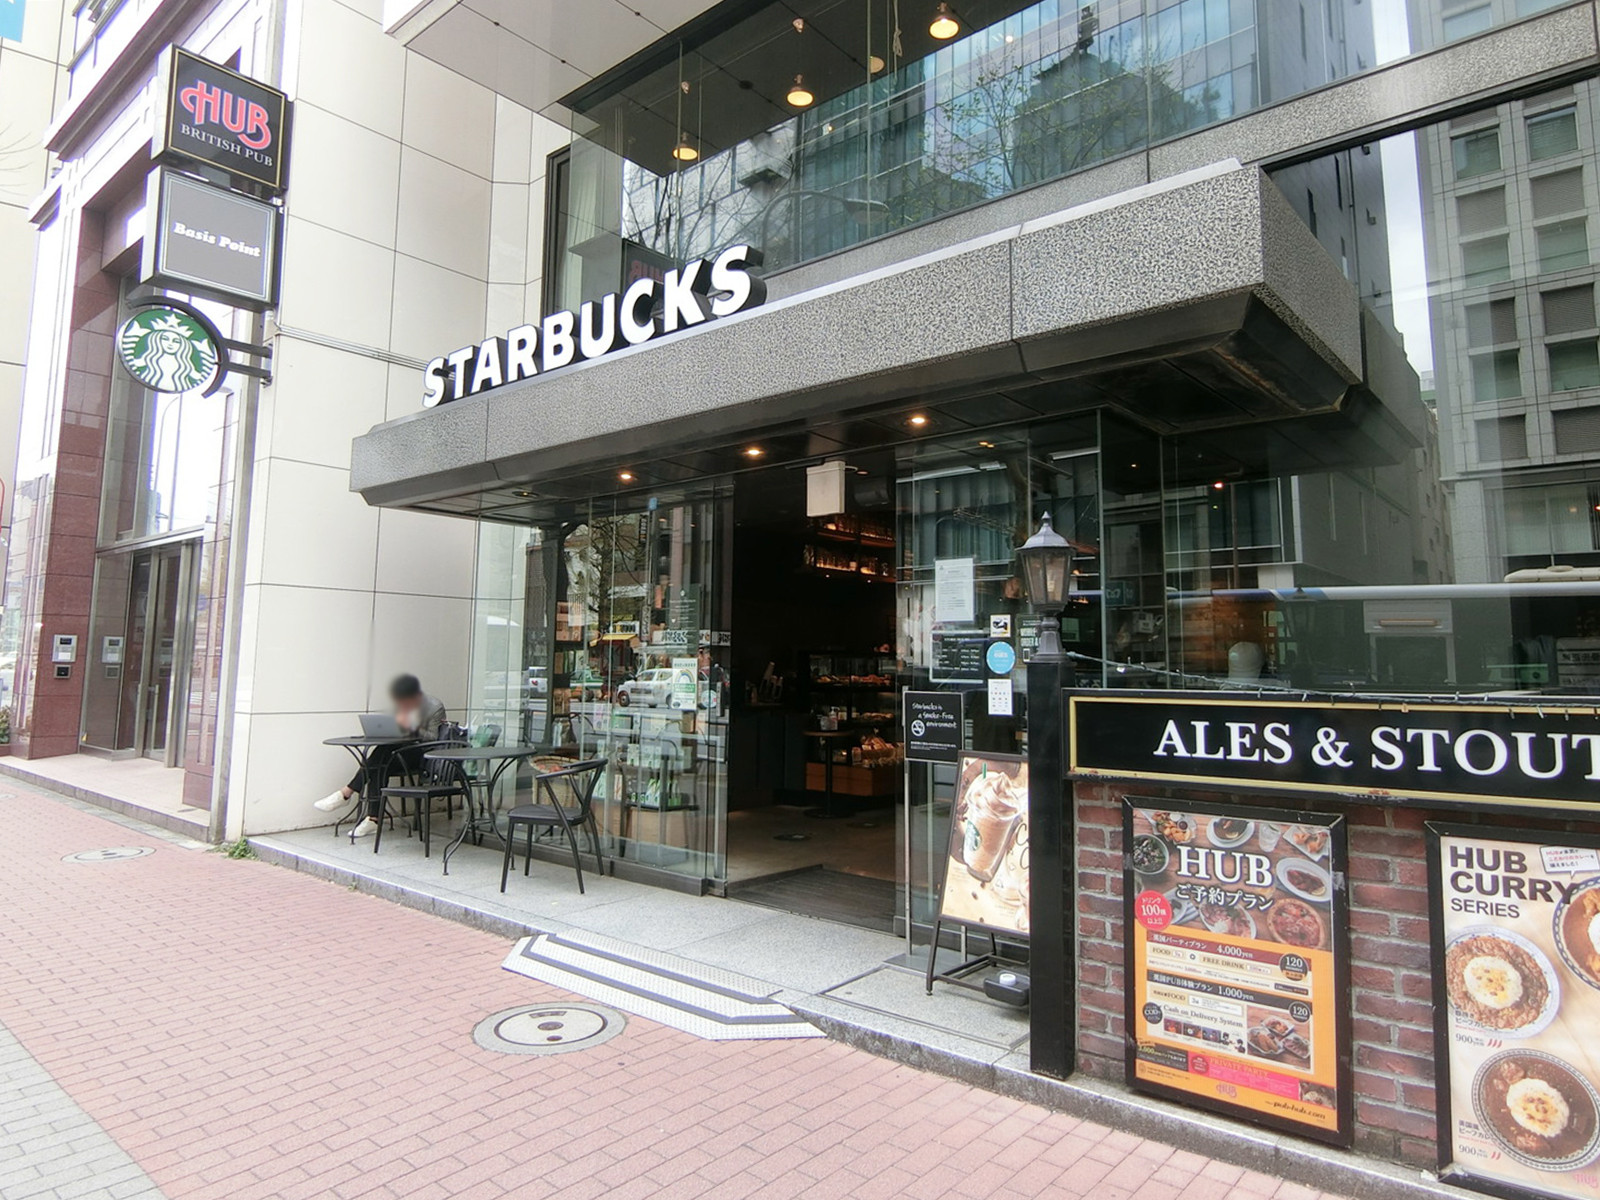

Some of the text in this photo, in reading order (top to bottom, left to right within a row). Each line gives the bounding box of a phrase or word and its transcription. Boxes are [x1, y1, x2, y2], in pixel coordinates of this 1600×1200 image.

[180, 79, 272, 150] HUB
[180, 123, 274, 168] BRITISH PUB
[173, 221, 262, 258] Basis Point
[422, 243, 754, 409] STARBUCKS
[1153, 719, 1294, 764] ALES
[1311, 726, 1354, 769] &
[1176, 845, 1273, 887] HUB
[1449, 845, 1528, 873] HUB
[1176, 883, 1274, 912] ご予約プラン
[1450, 870, 1580, 904] CURRY
[1451, 897, 1520, 919] SERIES
[1152, 946, 1171, 956] FOOD
[1202, 956, 1221, 966] FREE
[1221, 960, 1245, 970] DRINK
[1285, 956, 1304, 968] 120
[1163, 1005, 1180, 1014] Cash
[1190, 1010, 1218, 1024] Delivery
[1219, 1014, 1244, 1028] System
[1292, 1006, 1308, 1016] 120
